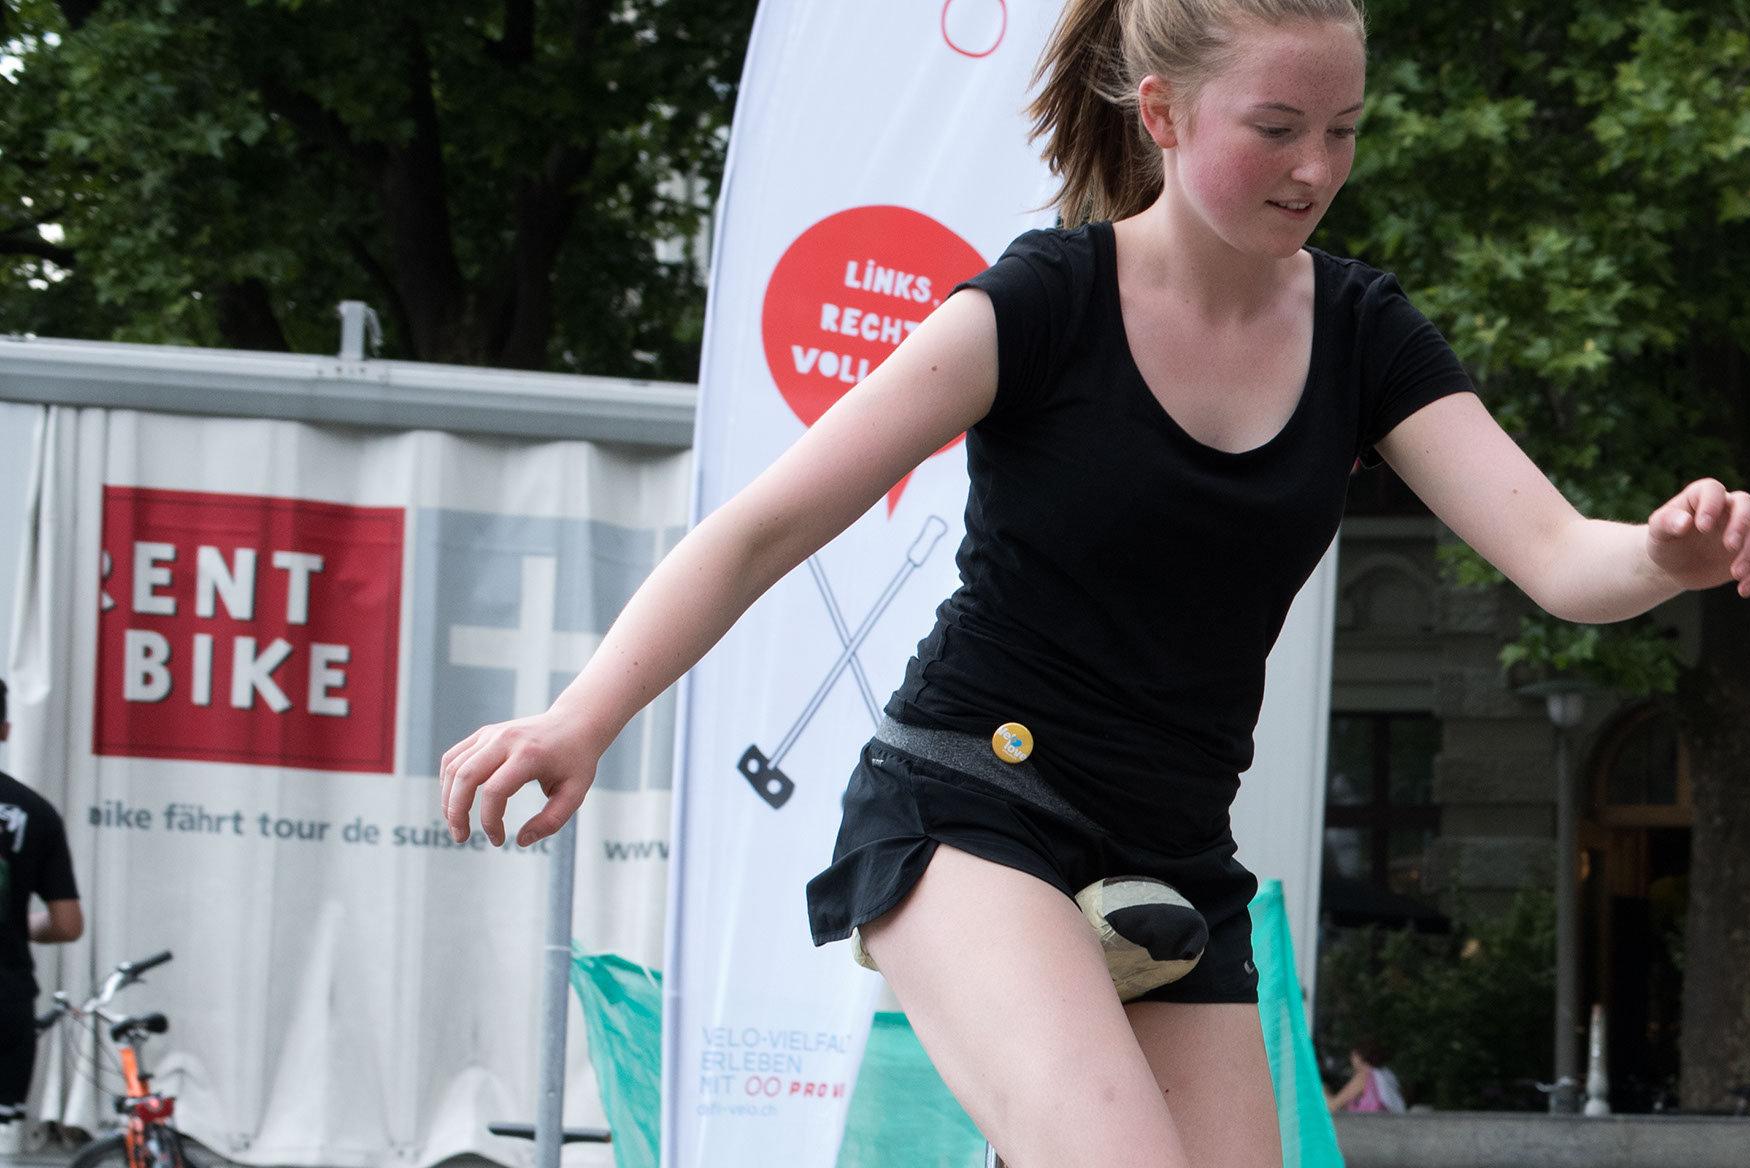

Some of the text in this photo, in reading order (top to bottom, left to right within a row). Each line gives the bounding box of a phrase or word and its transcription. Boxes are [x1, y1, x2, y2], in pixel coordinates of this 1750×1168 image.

[123, 628, 350, 718] BIKE
[164, 803, 243, 835] fährt
[258, 812, 330, 841] tour
[342, 818, 380, 845] de
[392, 821, 487, 851] suise
[702, 1028, 852, 1054] VELO-VIELFAL
[702, 1051, 804, 1074] ERLEBEN
[789, 1081, 828, 1098] PRO
